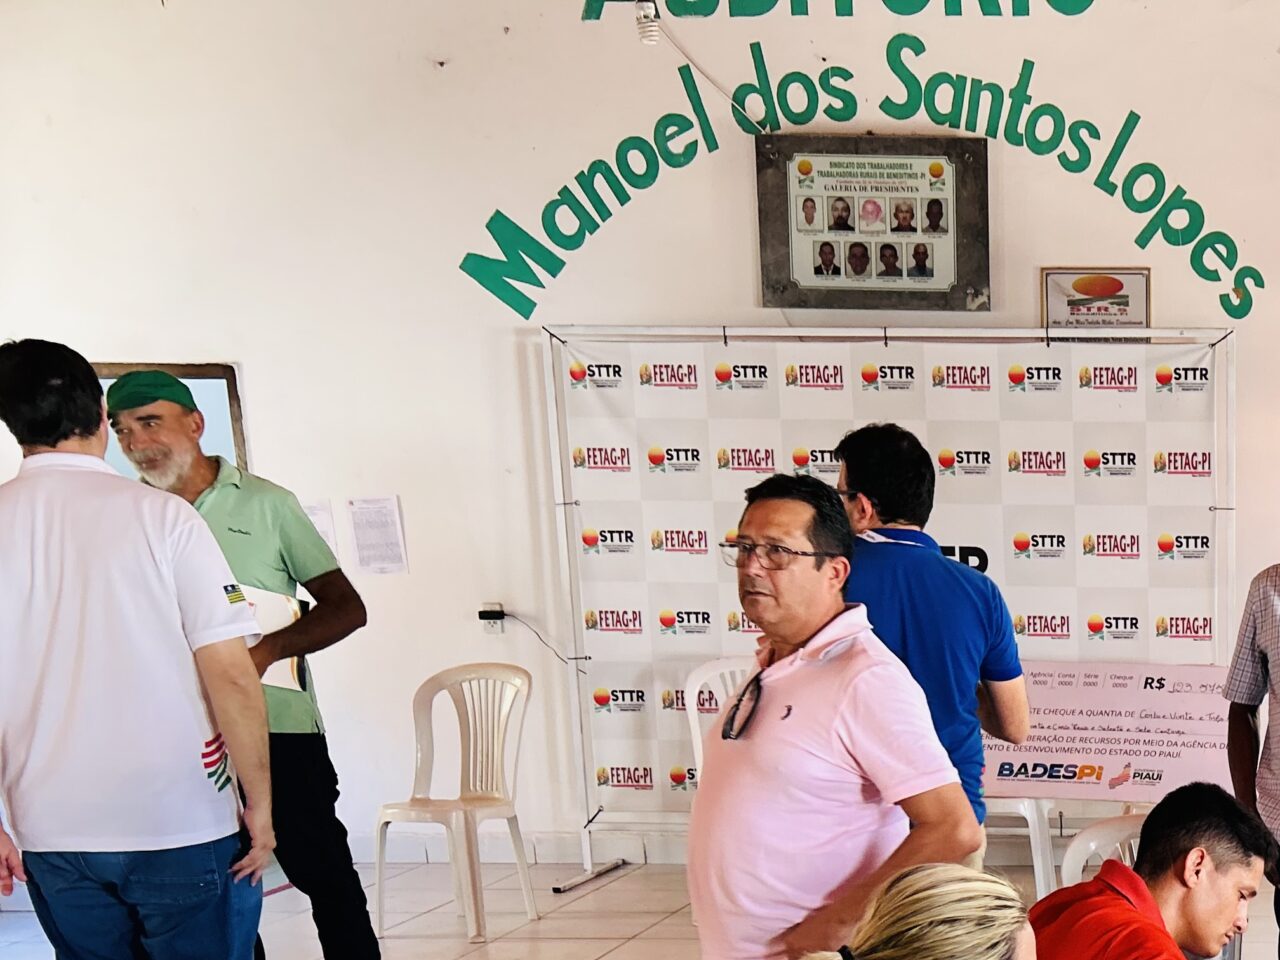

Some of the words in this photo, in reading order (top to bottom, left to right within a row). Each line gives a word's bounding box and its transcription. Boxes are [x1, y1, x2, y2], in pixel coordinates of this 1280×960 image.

[461, 65, 718, 320] Manoel
[733, 42, 857, 134] dos
[879, 33, 1100, 173] Santos
[1094, 111, 1266, 319] Lopes
[824, 184, 857, 192] GALERIA
[870, 185, 919, 193] PRESIDENTES
[587, 365, 622, 378] STTR
[653, 365, 697, 383] FETAG-PI
[732, 365, 768, 378] STTR
[799, 365, 843, 383] FETAG-PI
[879, 366, 914, 379] STTR
[946, 366, 990, 384] FETAG-PI
[1026, 367, 1061, 380] STTR
[1093, 367, 1137, 385] FETAG-PI
[1173, 368, 1208, 381] STTR
[586, 448, 630, 466] FETAG-PI
[665, 449, 700, 461] STTR
[731, 449, 774, 466] FETAG-PI
[956, 451, 990, 464] STTR
[1022, 452, 1065, 470] FETAG-PI
[1101, 452, 1136, 465] STTR
[1167, 452, 1211, 470] FETAG-PI
[600, 530, 634, 543] STTR
[665, 531, 707, 548] FETAG-PI
[1031, 535, 1065, 547] STTR
[1175, 536, 1209, 548] STTR
[1096, 535, 1139, 552] FETAG-PI
[599, 611, 641, 627] FETAG-PI
[677, 612, 710, 624] STTR
[1027, 616, 1069, 633] FETAG-PI
[1105, 617, 1138, 629] STTR
[1169, 617, 1212, 634] FETAG-PI
[1030, 671, 1053, 680] Agência
[1143, 676, 1166, 690] R$
[610, 690, 645, 702] STTR
[1043, 708, 1076, 717] CHEQUE
[1078, 708, 1084, 716] A
[1086, 708, 1122, 718] QUANTIA
[1124, 710, 1135, 718] DE
[1026, 734, 1064, 744] BERAÇÃO
[1079, 736, 1122, 745] RECURSOS
[1124, 738, 1141, 746] POR
[1143, 739, 1164, 747] MEIO
[1166, 740, 1178, 748] DA
[1180, 739, 1216, 749] AGÊNCIA
[982, 744, 1004, 752] ENTO
[1006, 744, 1012, 752] E
[1013, 744, 1092, 755] DESENVOLVIMENTO
[1109, 748, 1141, 757] ESTADO
[610, 767, 652, 784] FETAG-PI
